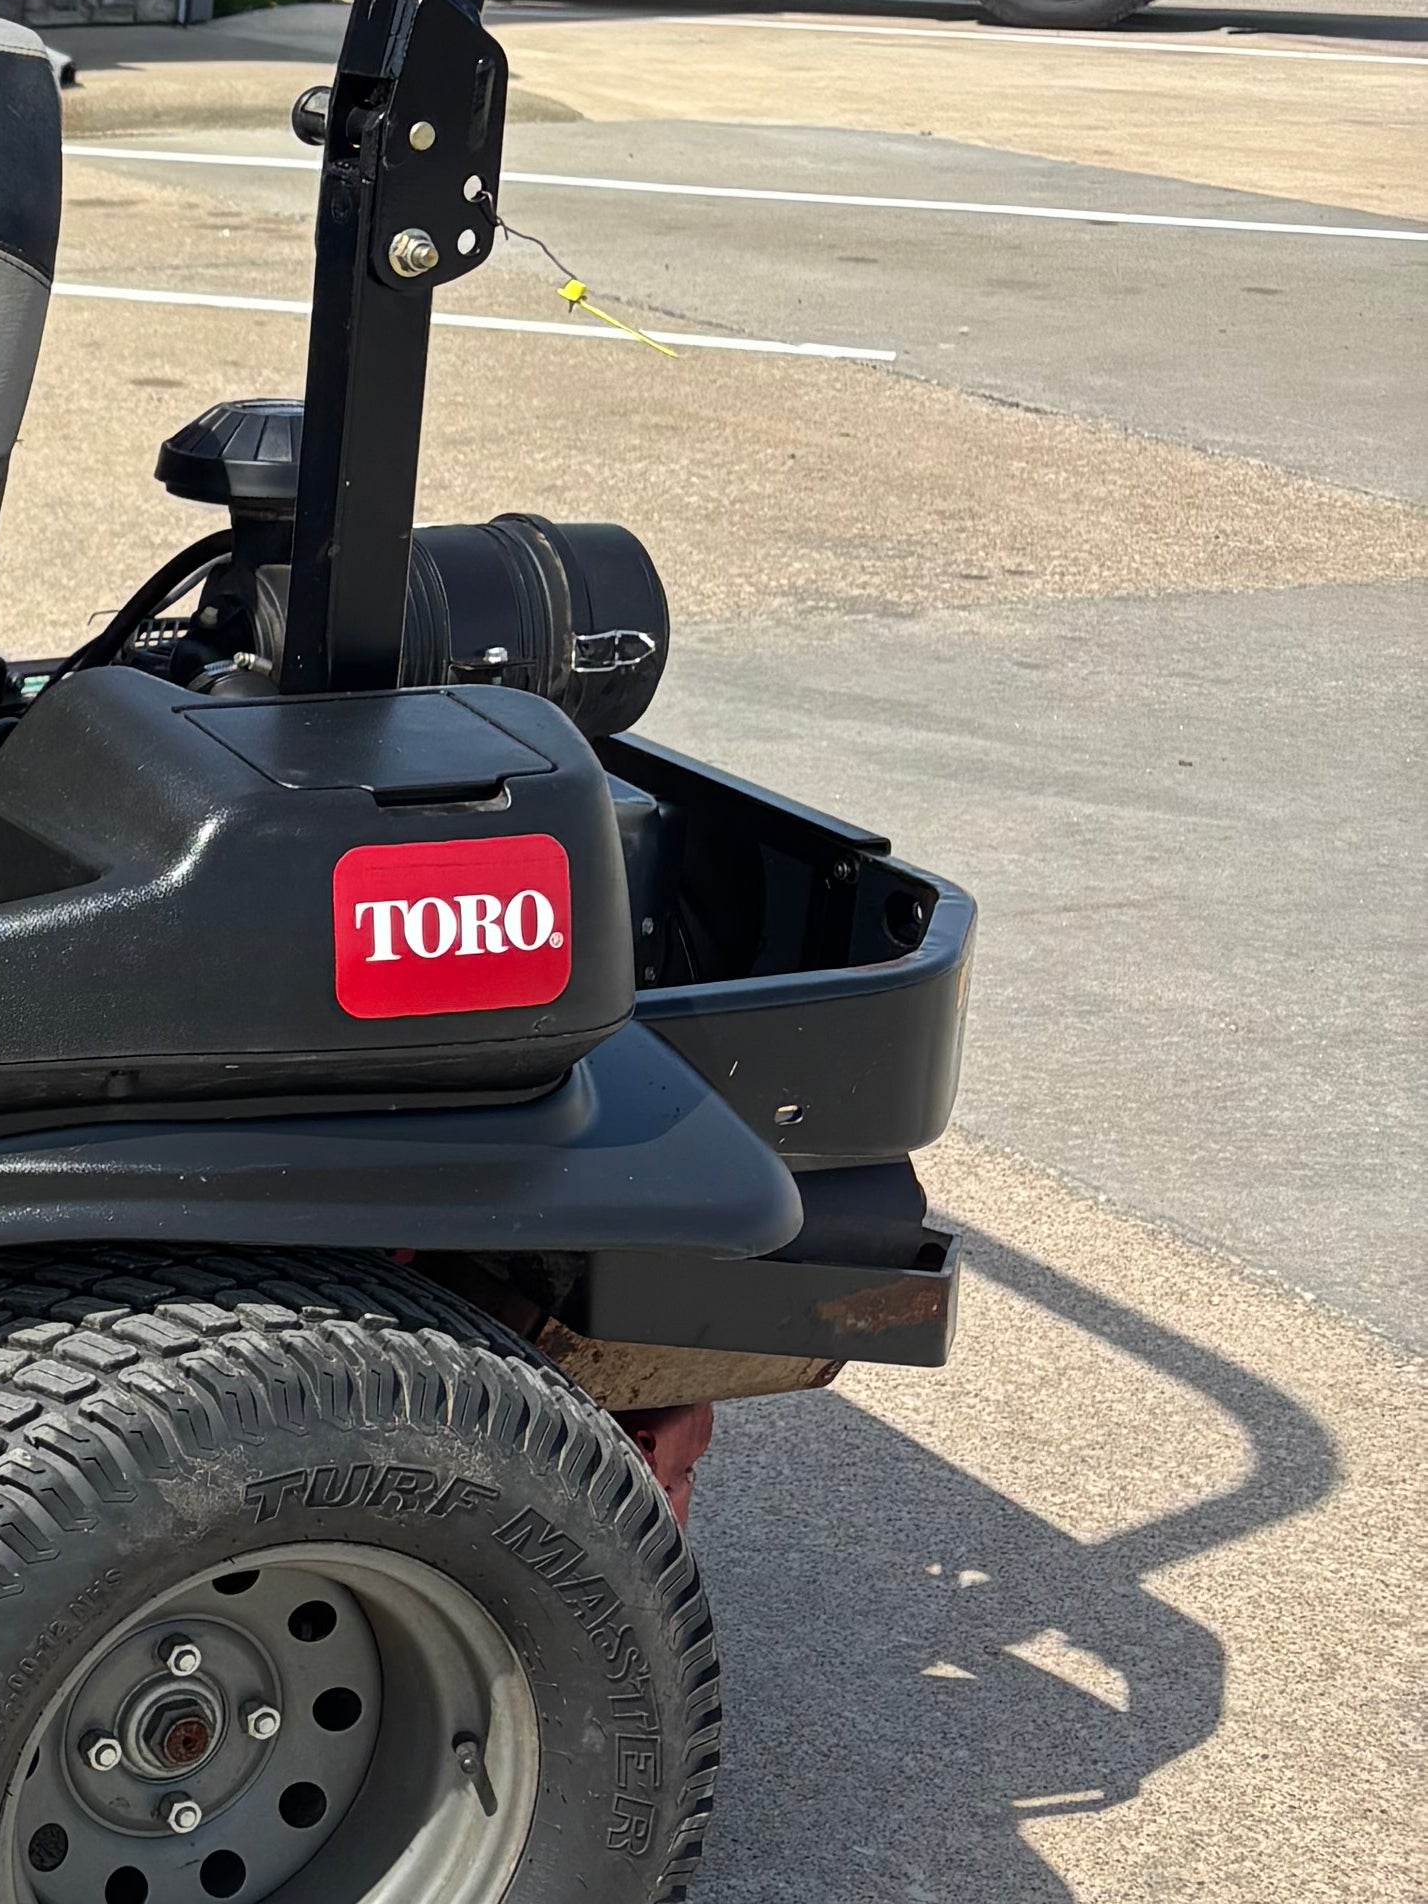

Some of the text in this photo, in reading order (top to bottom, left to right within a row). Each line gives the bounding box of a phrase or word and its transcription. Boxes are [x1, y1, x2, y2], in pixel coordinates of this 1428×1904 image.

[354, 889, 555, 963] TORO
[244, 1462, 662, 1858] TURF MASTER
